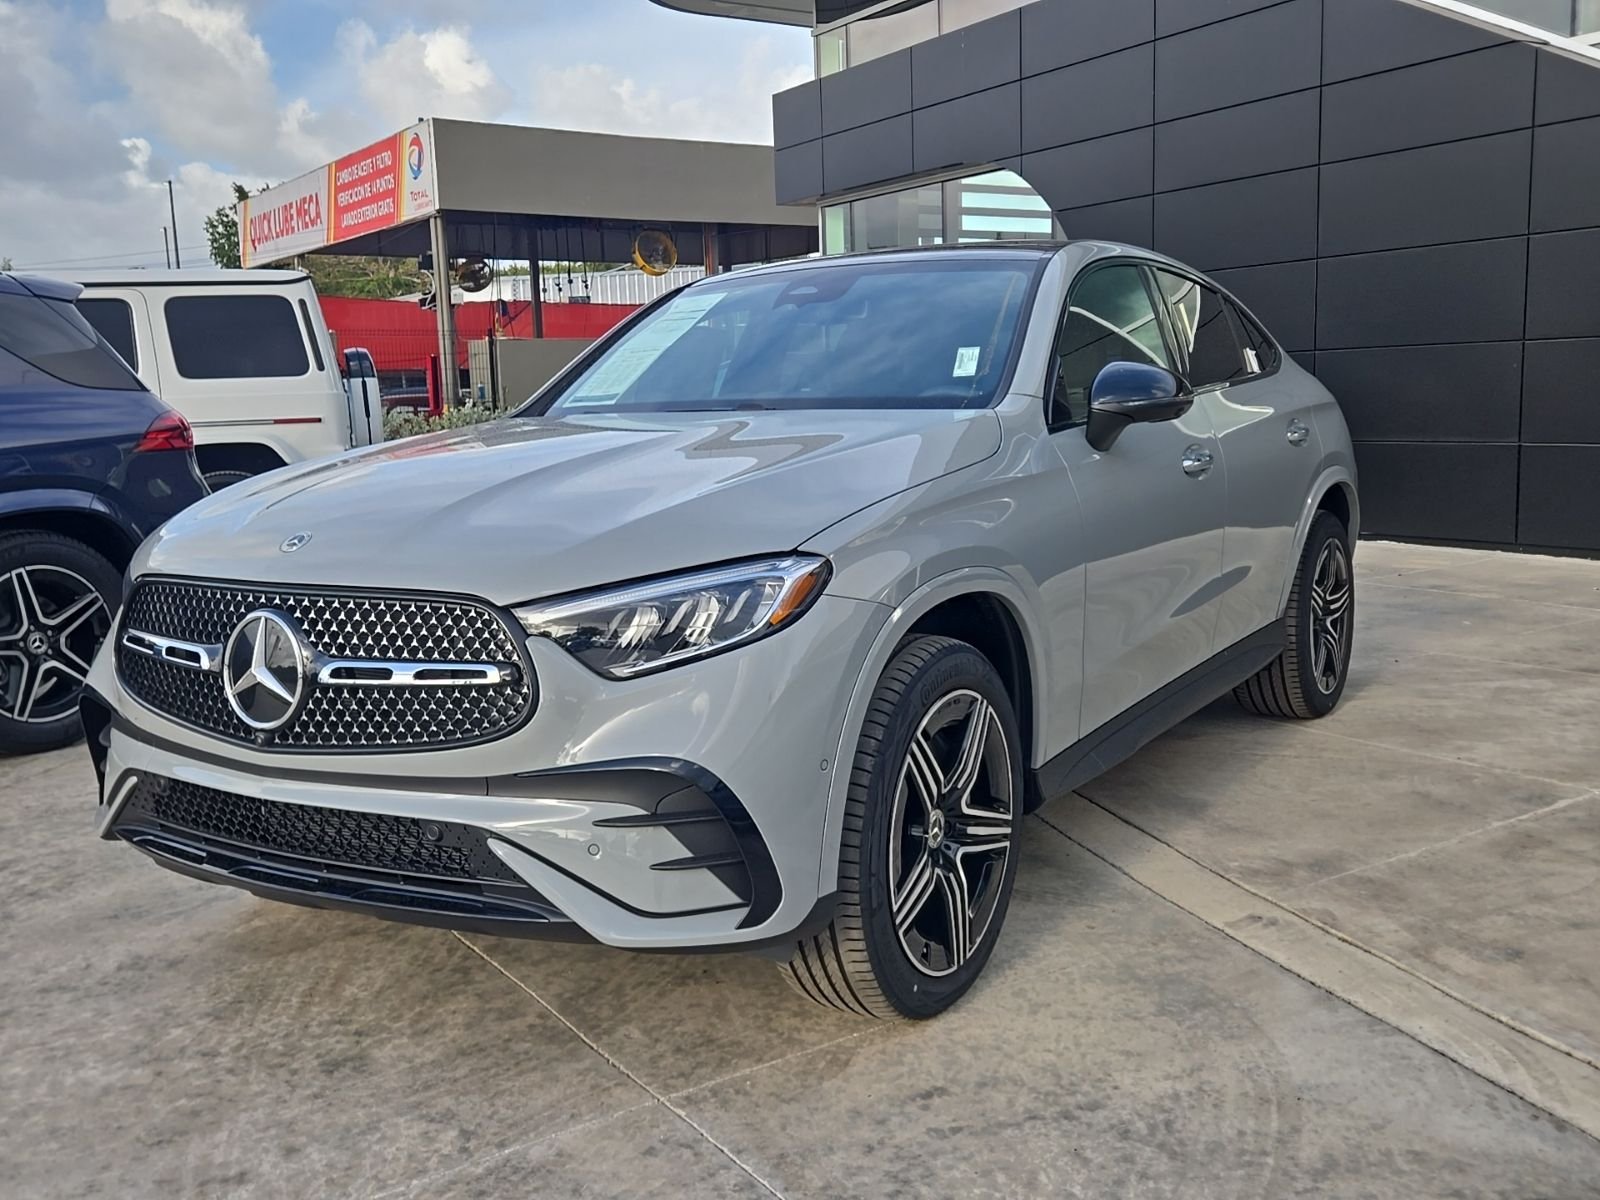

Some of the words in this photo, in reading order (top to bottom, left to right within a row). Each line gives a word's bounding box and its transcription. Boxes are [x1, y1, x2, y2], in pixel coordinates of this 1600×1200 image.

[376, 150, 392, 169] FILTRO
[376, 173, 395, 193] PUNTOS
[410, 188, 429, 202] TOTAL
[377, 197, 394, 217] GRATIS
[250, 210, 274, 252] QUICK
[273, 203, 295, 239] LUBE
[296, 192, 322, 232] MECA
